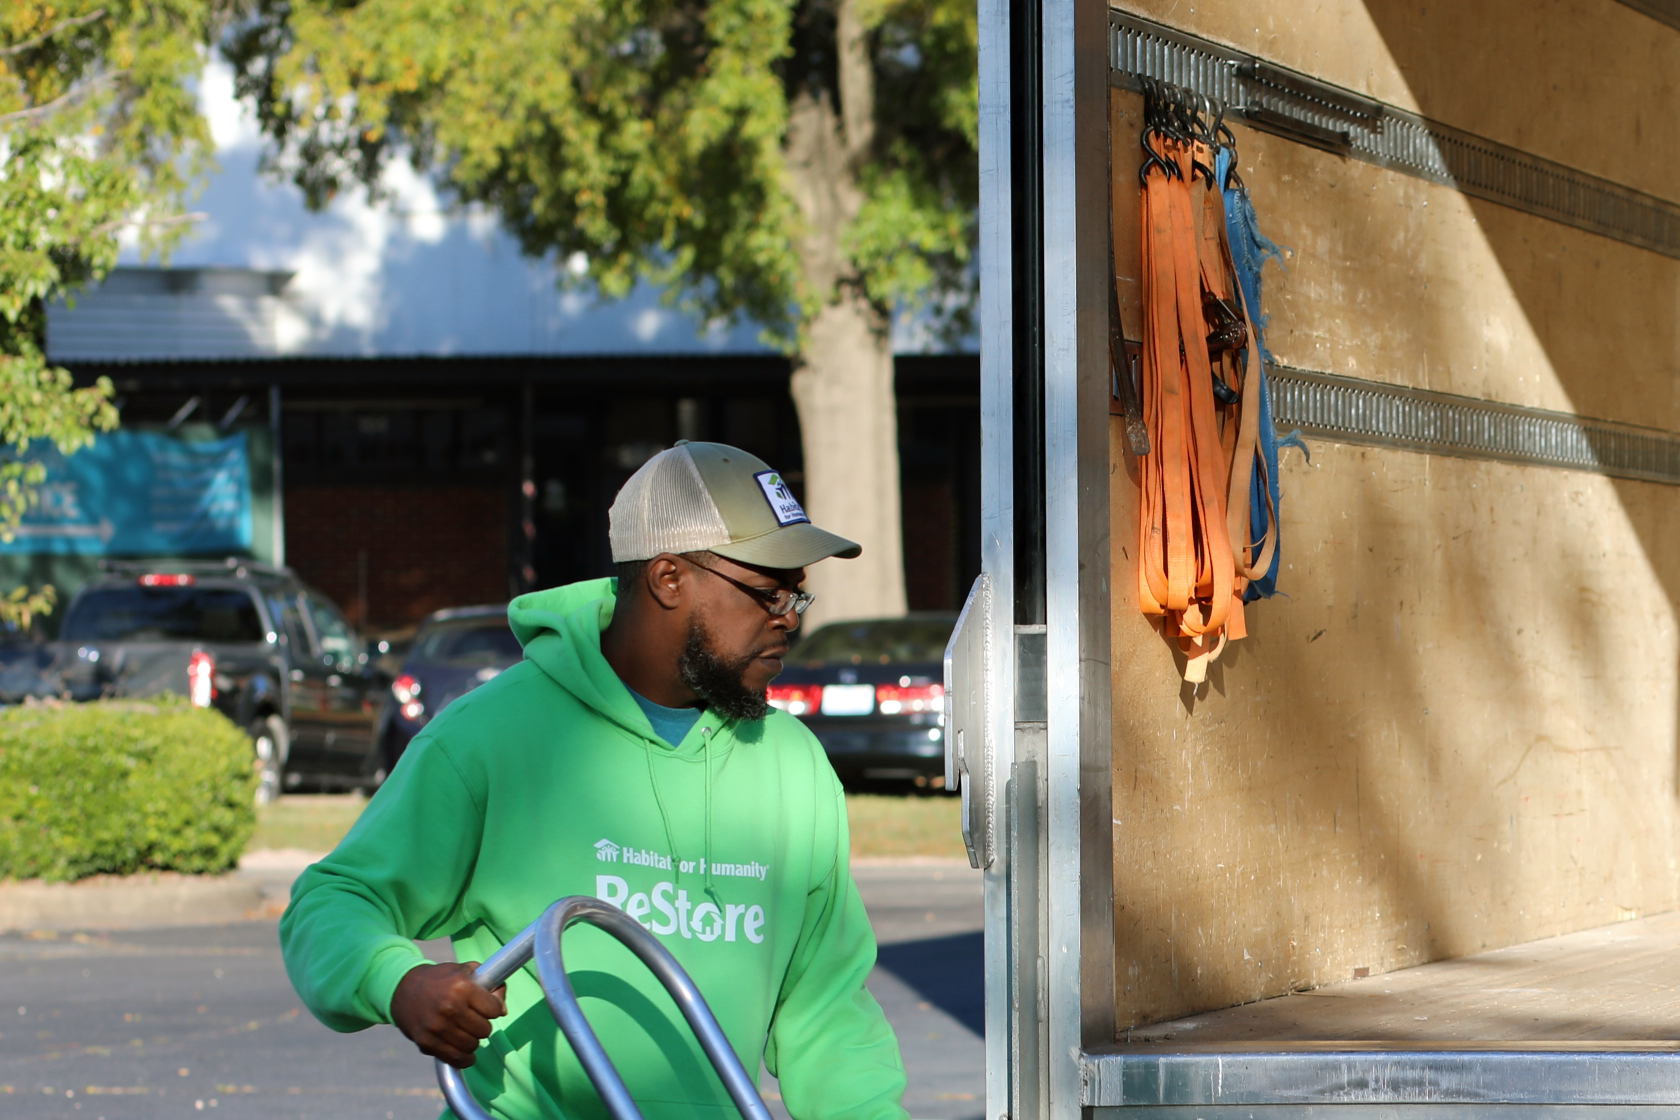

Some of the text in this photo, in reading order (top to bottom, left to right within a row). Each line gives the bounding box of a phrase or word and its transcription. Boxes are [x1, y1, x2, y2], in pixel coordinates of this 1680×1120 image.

[622, 846, 672, 871] Habitat
[679, 859, 697, 874] or
[596, 875, 765, 944] ReStore
